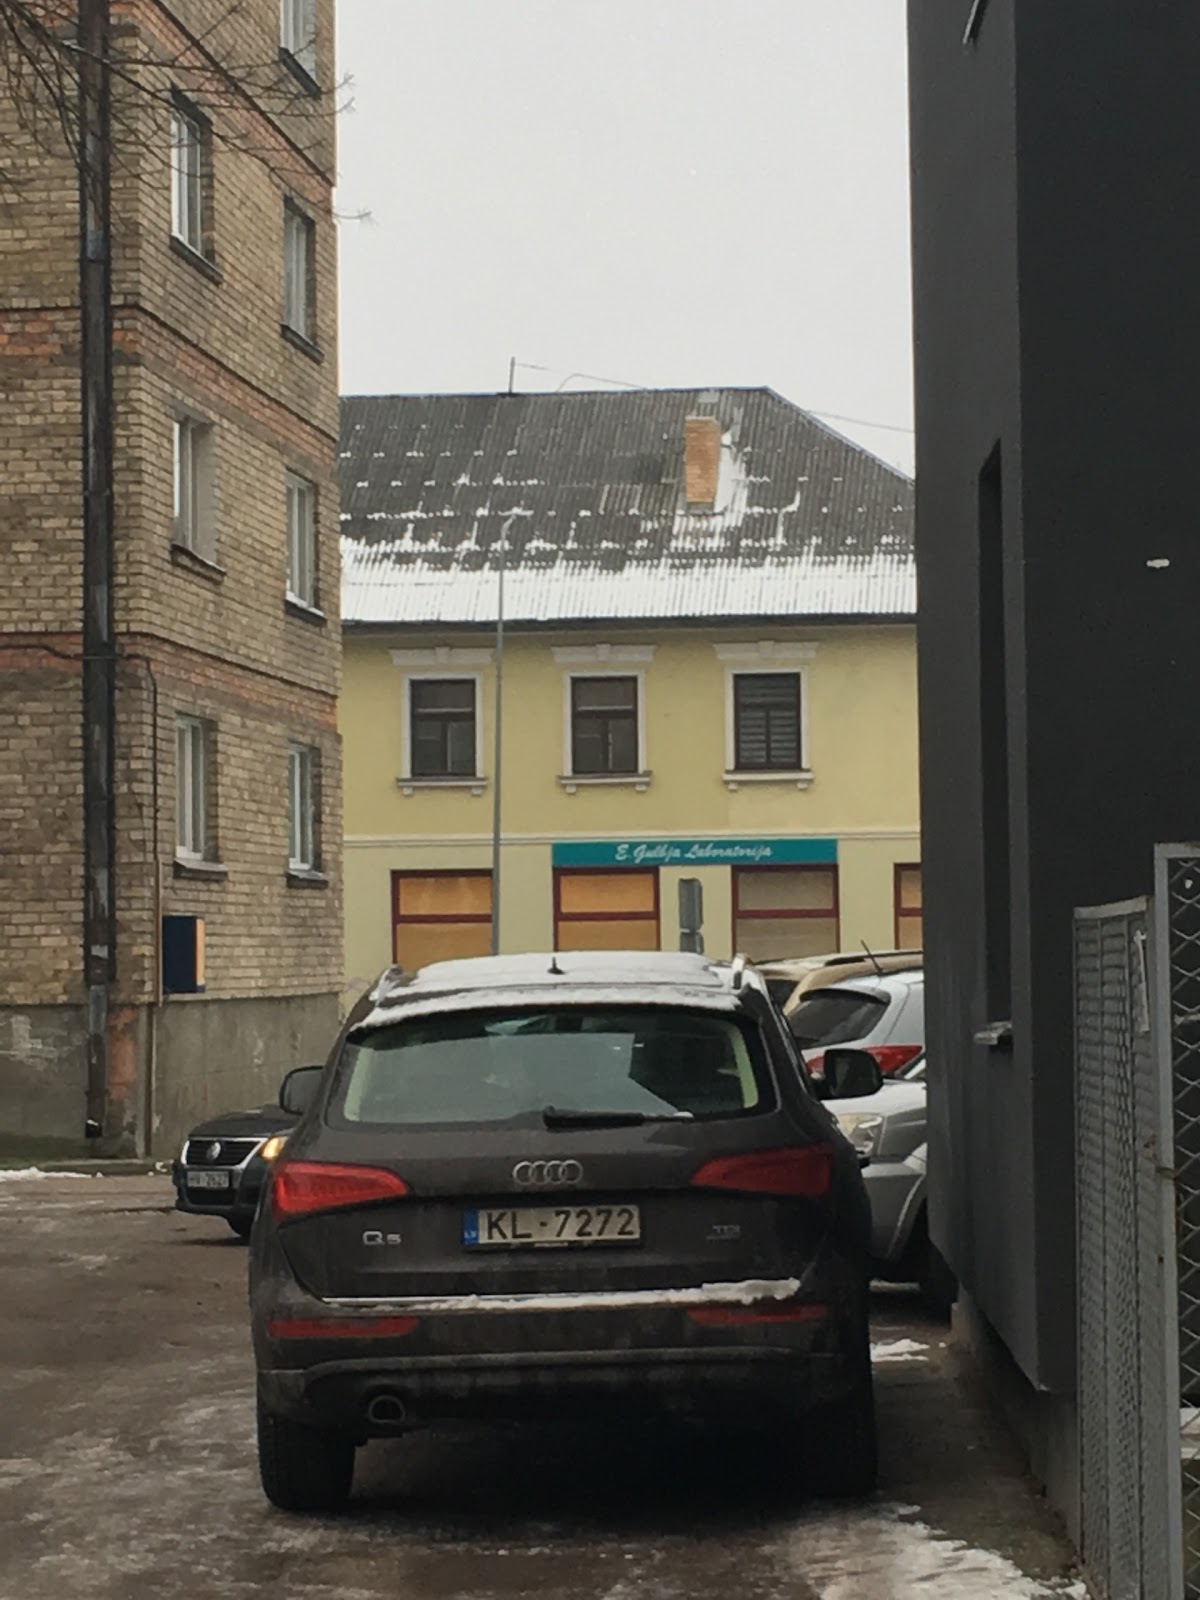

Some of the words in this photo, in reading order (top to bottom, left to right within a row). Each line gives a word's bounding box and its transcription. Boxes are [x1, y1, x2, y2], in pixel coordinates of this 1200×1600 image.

[684, 843, 773, 861] Laboratorija
[487, 1209, 634, 1240] KL-7272
[363, 1231, 402, 1245] Q5
